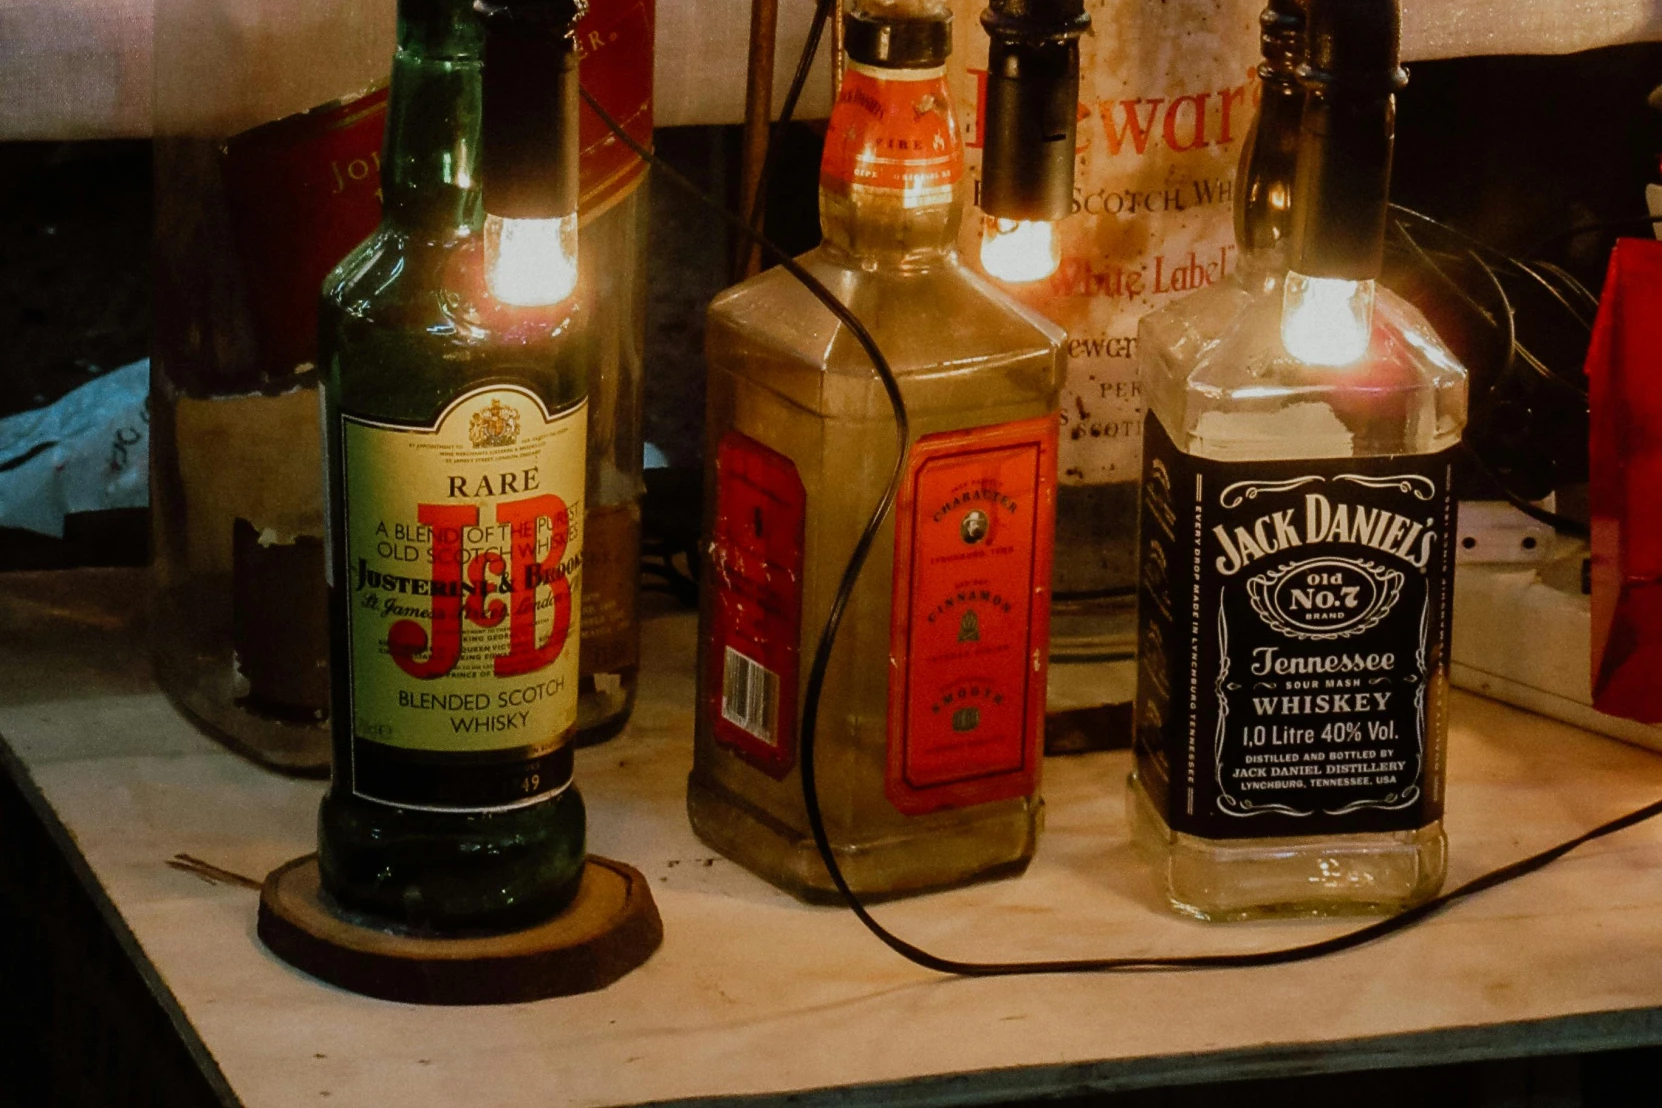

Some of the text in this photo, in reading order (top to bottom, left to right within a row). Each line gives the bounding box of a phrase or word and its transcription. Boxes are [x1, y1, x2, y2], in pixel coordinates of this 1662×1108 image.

[447, 466, 541, 498] RARE
[375, 500, 580, 544] A BLEND OF THE PUREST
[933, 489, 1019, 523] CHARACTER
[377, 523, 578, 565] OLD SCOTCH WHISKIES
[1212, 492, 1438, 577] JACK DANIEL'S
[356, 556, 496, 598] JUSTERINI
[498, 570, 514, 594] &
[927, 590, 1013, 623] CINNAMON
[1305, 610, 1346, 621] BRAND
[1186, 505, 1203, 784] EVERY DROP MADE IN LYNCHBURG TENNESSEE
[1250, 645, 1396, 677] Tennessee
[398, 675, 565, 711] BLENDED SCOTCH
[1285, 678, 1362, 690] SOUR MASH
[1252, 691, 1393, 717] WHISKEY
[450, 710, 530, 734] WHISKY
[1271, 723, 1316, 746] Litre
[1320, 720, 1364, 744] 40%
[1366, 719, 1400, 742] Vol.
[1231, 760, 1407, 780] JACK DANIEL DISTILLERY
[1244, 748, 1395, 765] DISTILLED AND BOTTLED BY
[1375, 774, 1398, 785] USA
